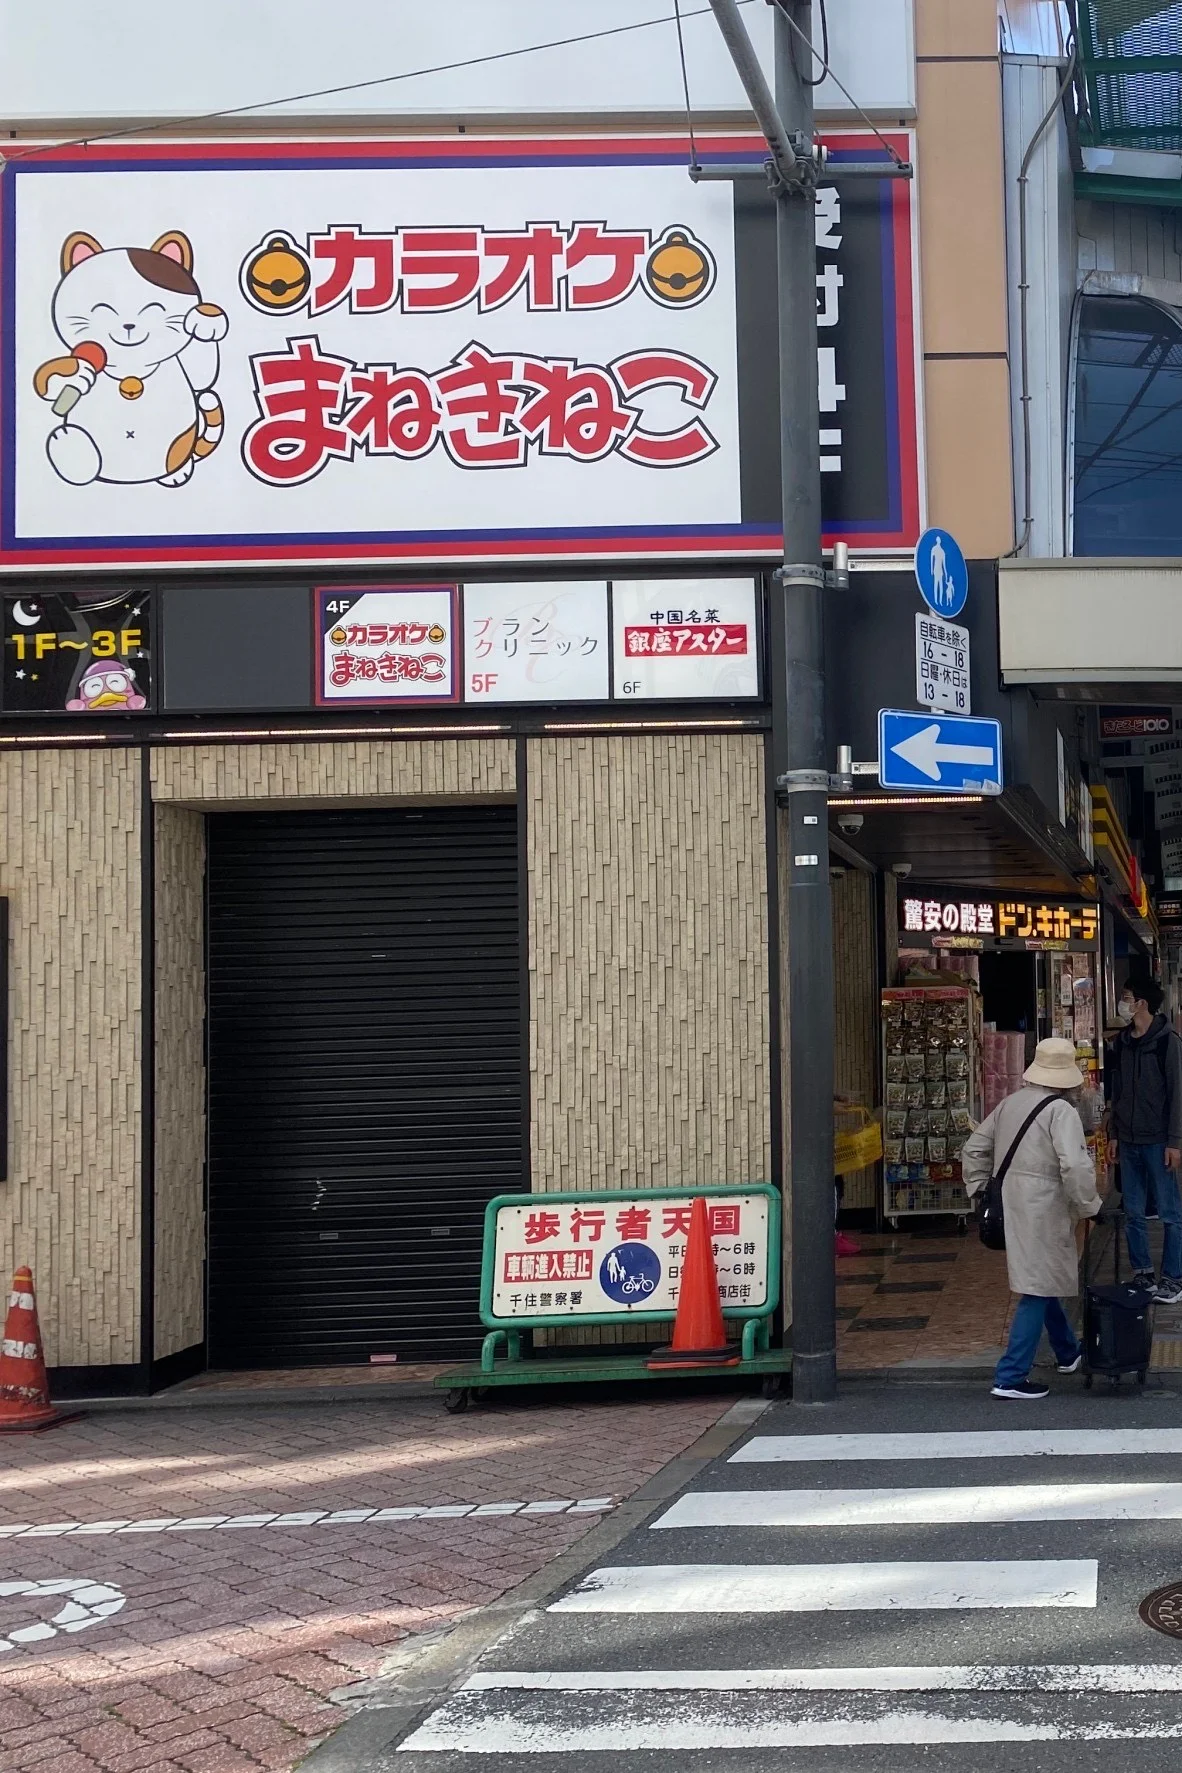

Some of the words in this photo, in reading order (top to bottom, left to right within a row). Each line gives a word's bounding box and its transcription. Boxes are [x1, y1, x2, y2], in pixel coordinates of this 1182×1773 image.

[310, 223, 650, 313] カラオケ
[244, 339, 716, 484] まねきねこ
[326, 600, 351, 615] 4F
[649, 608, 721, 624] 中国名菜
[347, 623, 431, 645] カラオケ
[473, 616, 549, 638] ブラン
[920, 620, 967, 649] 自転車を除く
[473, 634, 600, 659] クリニック
[626, 627, 745, 653] 銀座アスター
[329, 652, 445, 687] まねきねこ
[472, 674, 499, 692] 5F
[623, 681, 642, 695] 6F
[904, 899, 995, 934] 驚安の殿堂
[524, 1204, 740, 1244] 歩行者天国
[510, 1290, 583, 1307] 千住警察署
